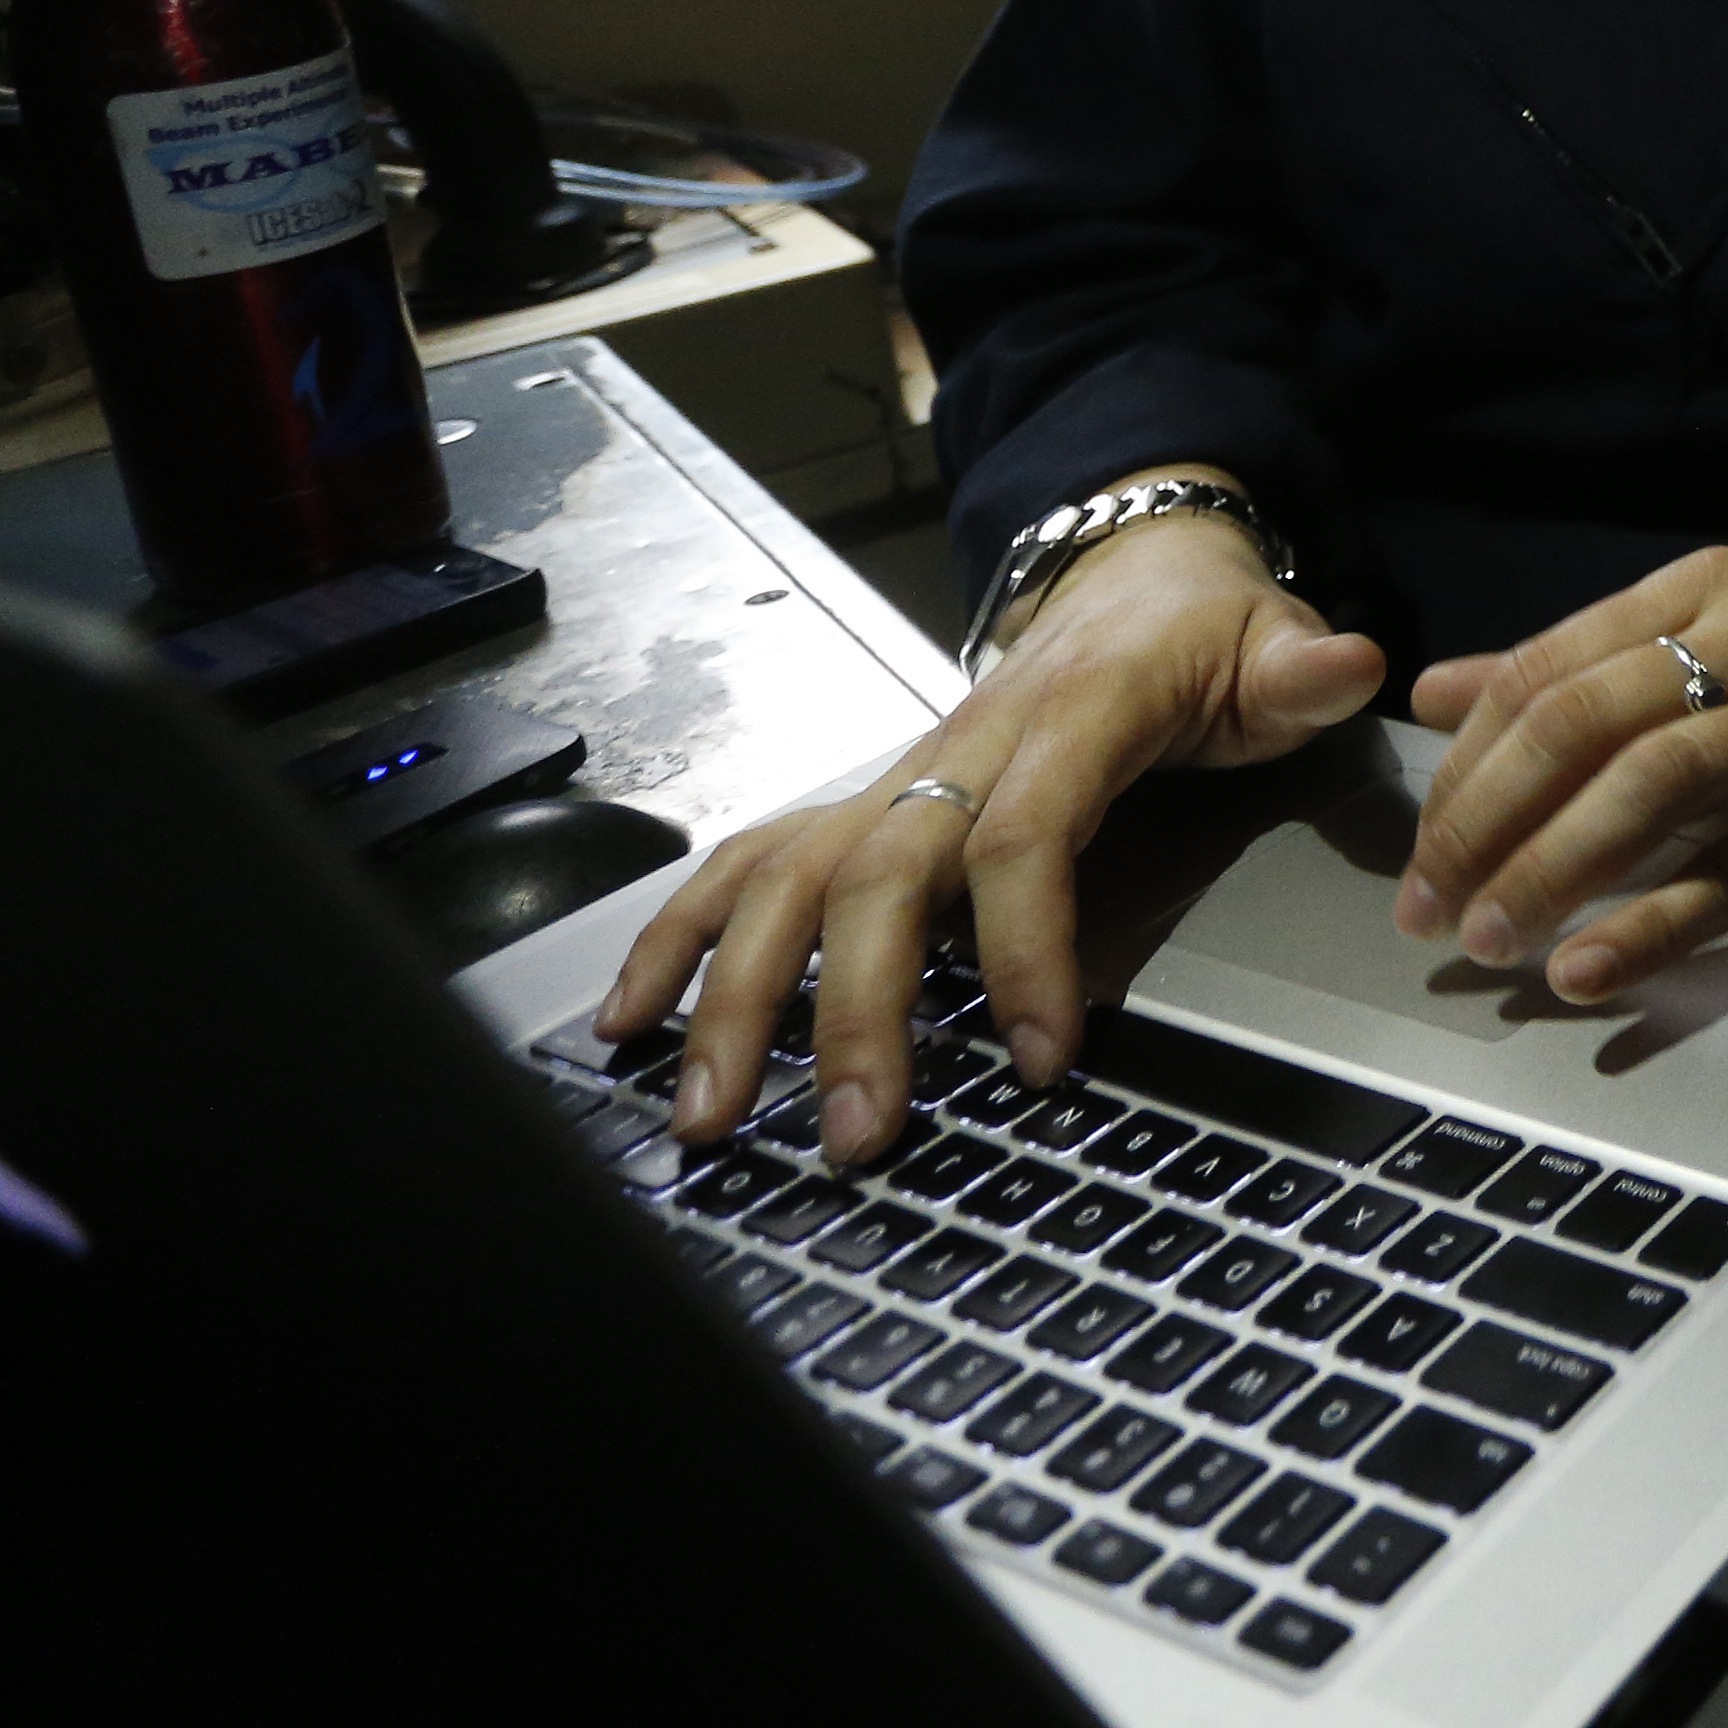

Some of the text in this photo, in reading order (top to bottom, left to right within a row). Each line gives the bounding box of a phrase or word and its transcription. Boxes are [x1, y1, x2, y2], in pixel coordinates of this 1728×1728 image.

[181, 85, 282, 116] Multiple
[988, 1083, 1020, 1104] M
[1053, 1107, 1084, 1128] N
[1433, 1120, 1506, 1150] command
[1195, 1157, 1220, 1177] V
[1539, 1153, 1586, 1175] option
[1001, 1179, 1033, 1201] H
[1269, 1181, 1295, 1201] C
[1613, 1177, 1669, 1202] control
[1345, 1206, 1375, 1230] X
[1305, 1289, 1332, 1311] S
[1627, 1282, 1664, 1304] shift
[1388, 1317, 1415, 1341] A
[1230, 1369, 1268, 1397] W
